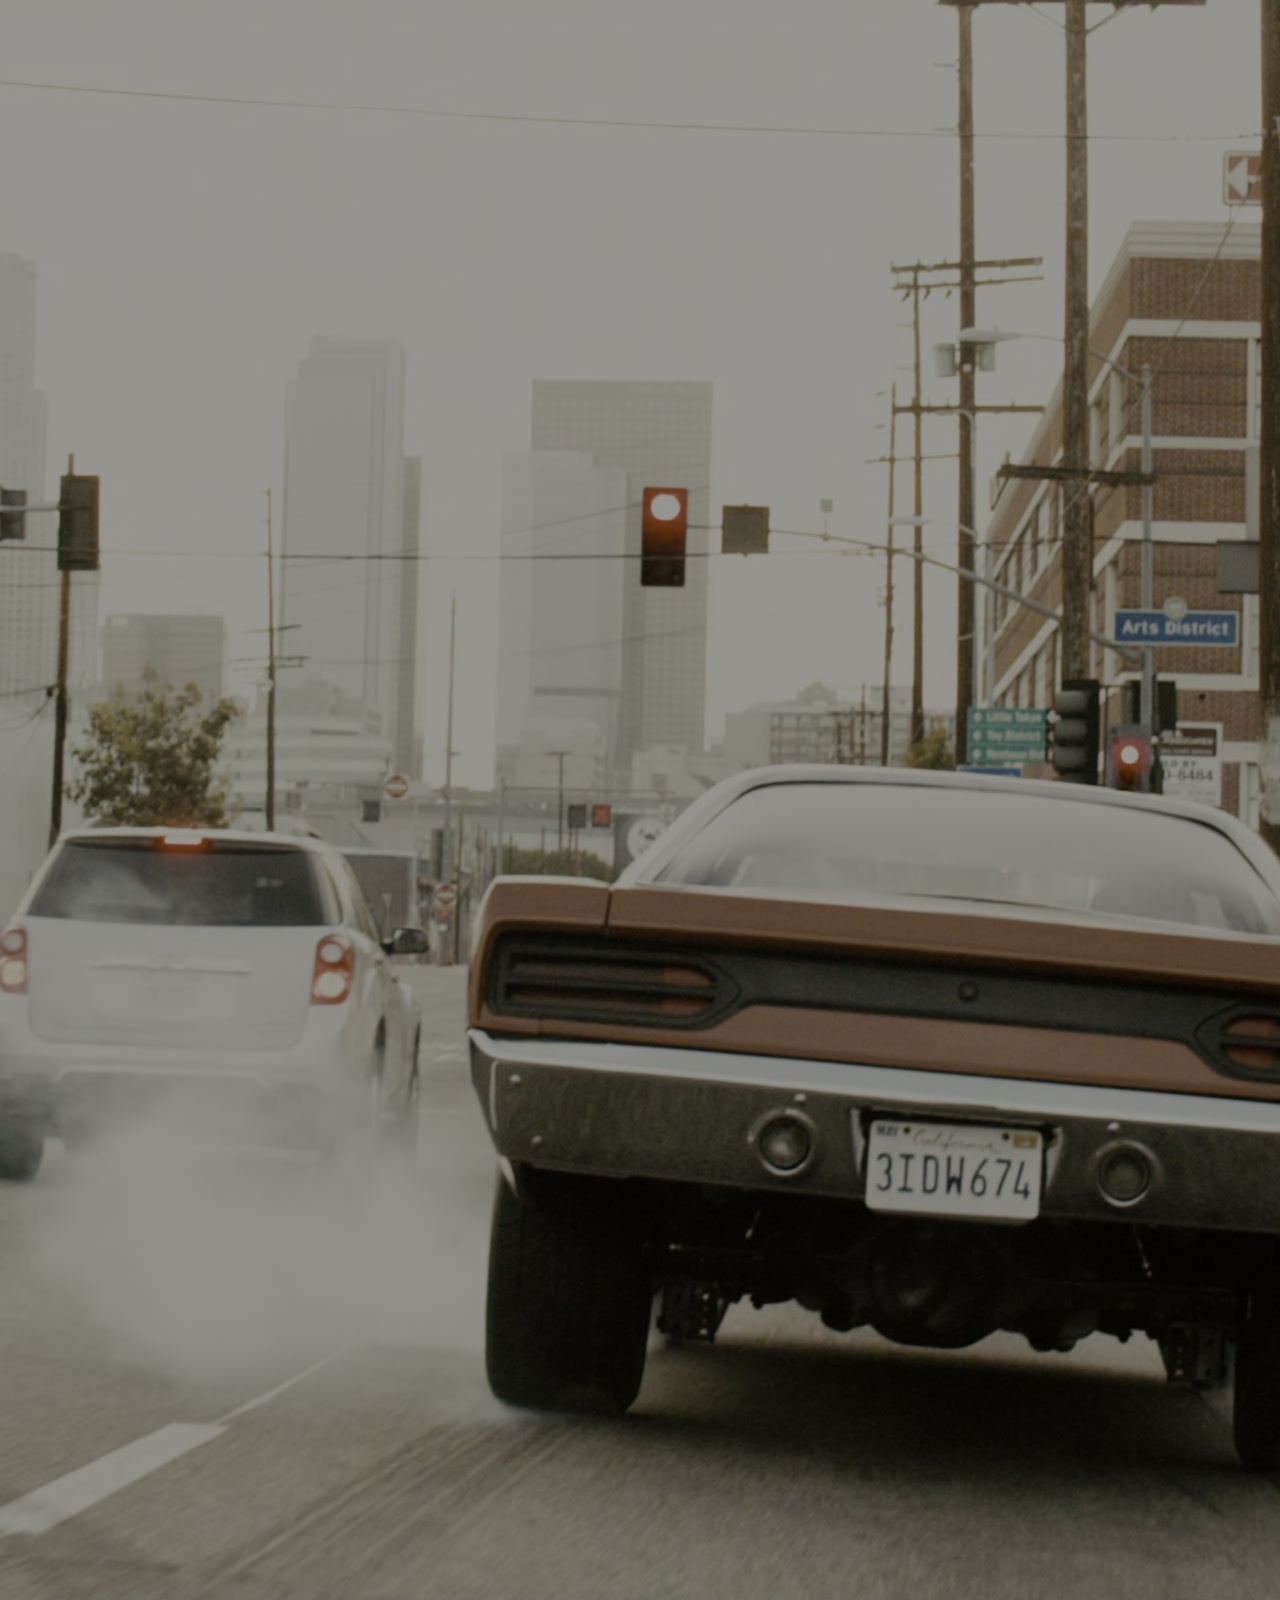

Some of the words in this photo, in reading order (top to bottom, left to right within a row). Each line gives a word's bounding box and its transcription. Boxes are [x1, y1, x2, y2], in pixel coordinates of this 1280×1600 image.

[1121, 619, 1160, 636] Arts
[1164, 620, 1230, 636] District
[912, 1126, 997, 1152] California
[876, 1153, 1030, 1200] 3IDW674
